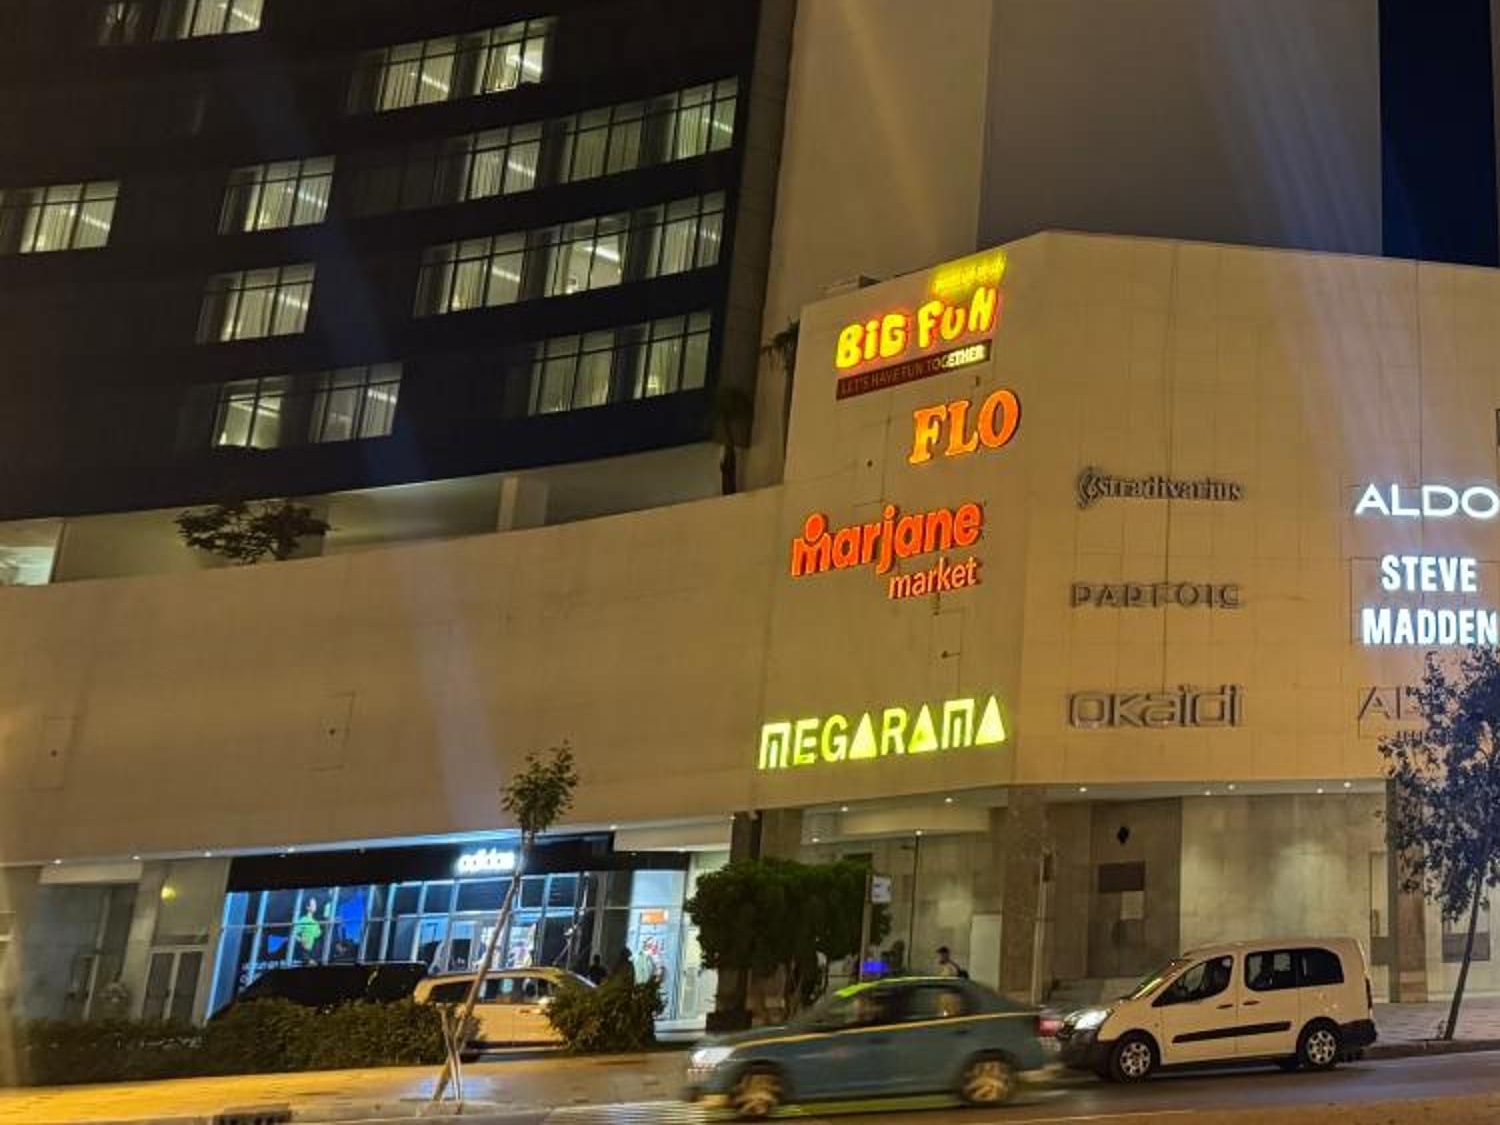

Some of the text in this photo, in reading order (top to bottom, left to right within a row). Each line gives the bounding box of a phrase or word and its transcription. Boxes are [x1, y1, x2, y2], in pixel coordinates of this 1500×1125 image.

[926, 344, 986, 372] TOGETHER
[908, 389, 1020, 464] FLO
[791, 503, 984, 577] marjane
[888, 556, 980, 601] market
[1380, 554, 1478, 593] STEVE
[1361, 607, 1499, 645] MADDEN
[758, 695, 1006, 770] MEGARAMA
